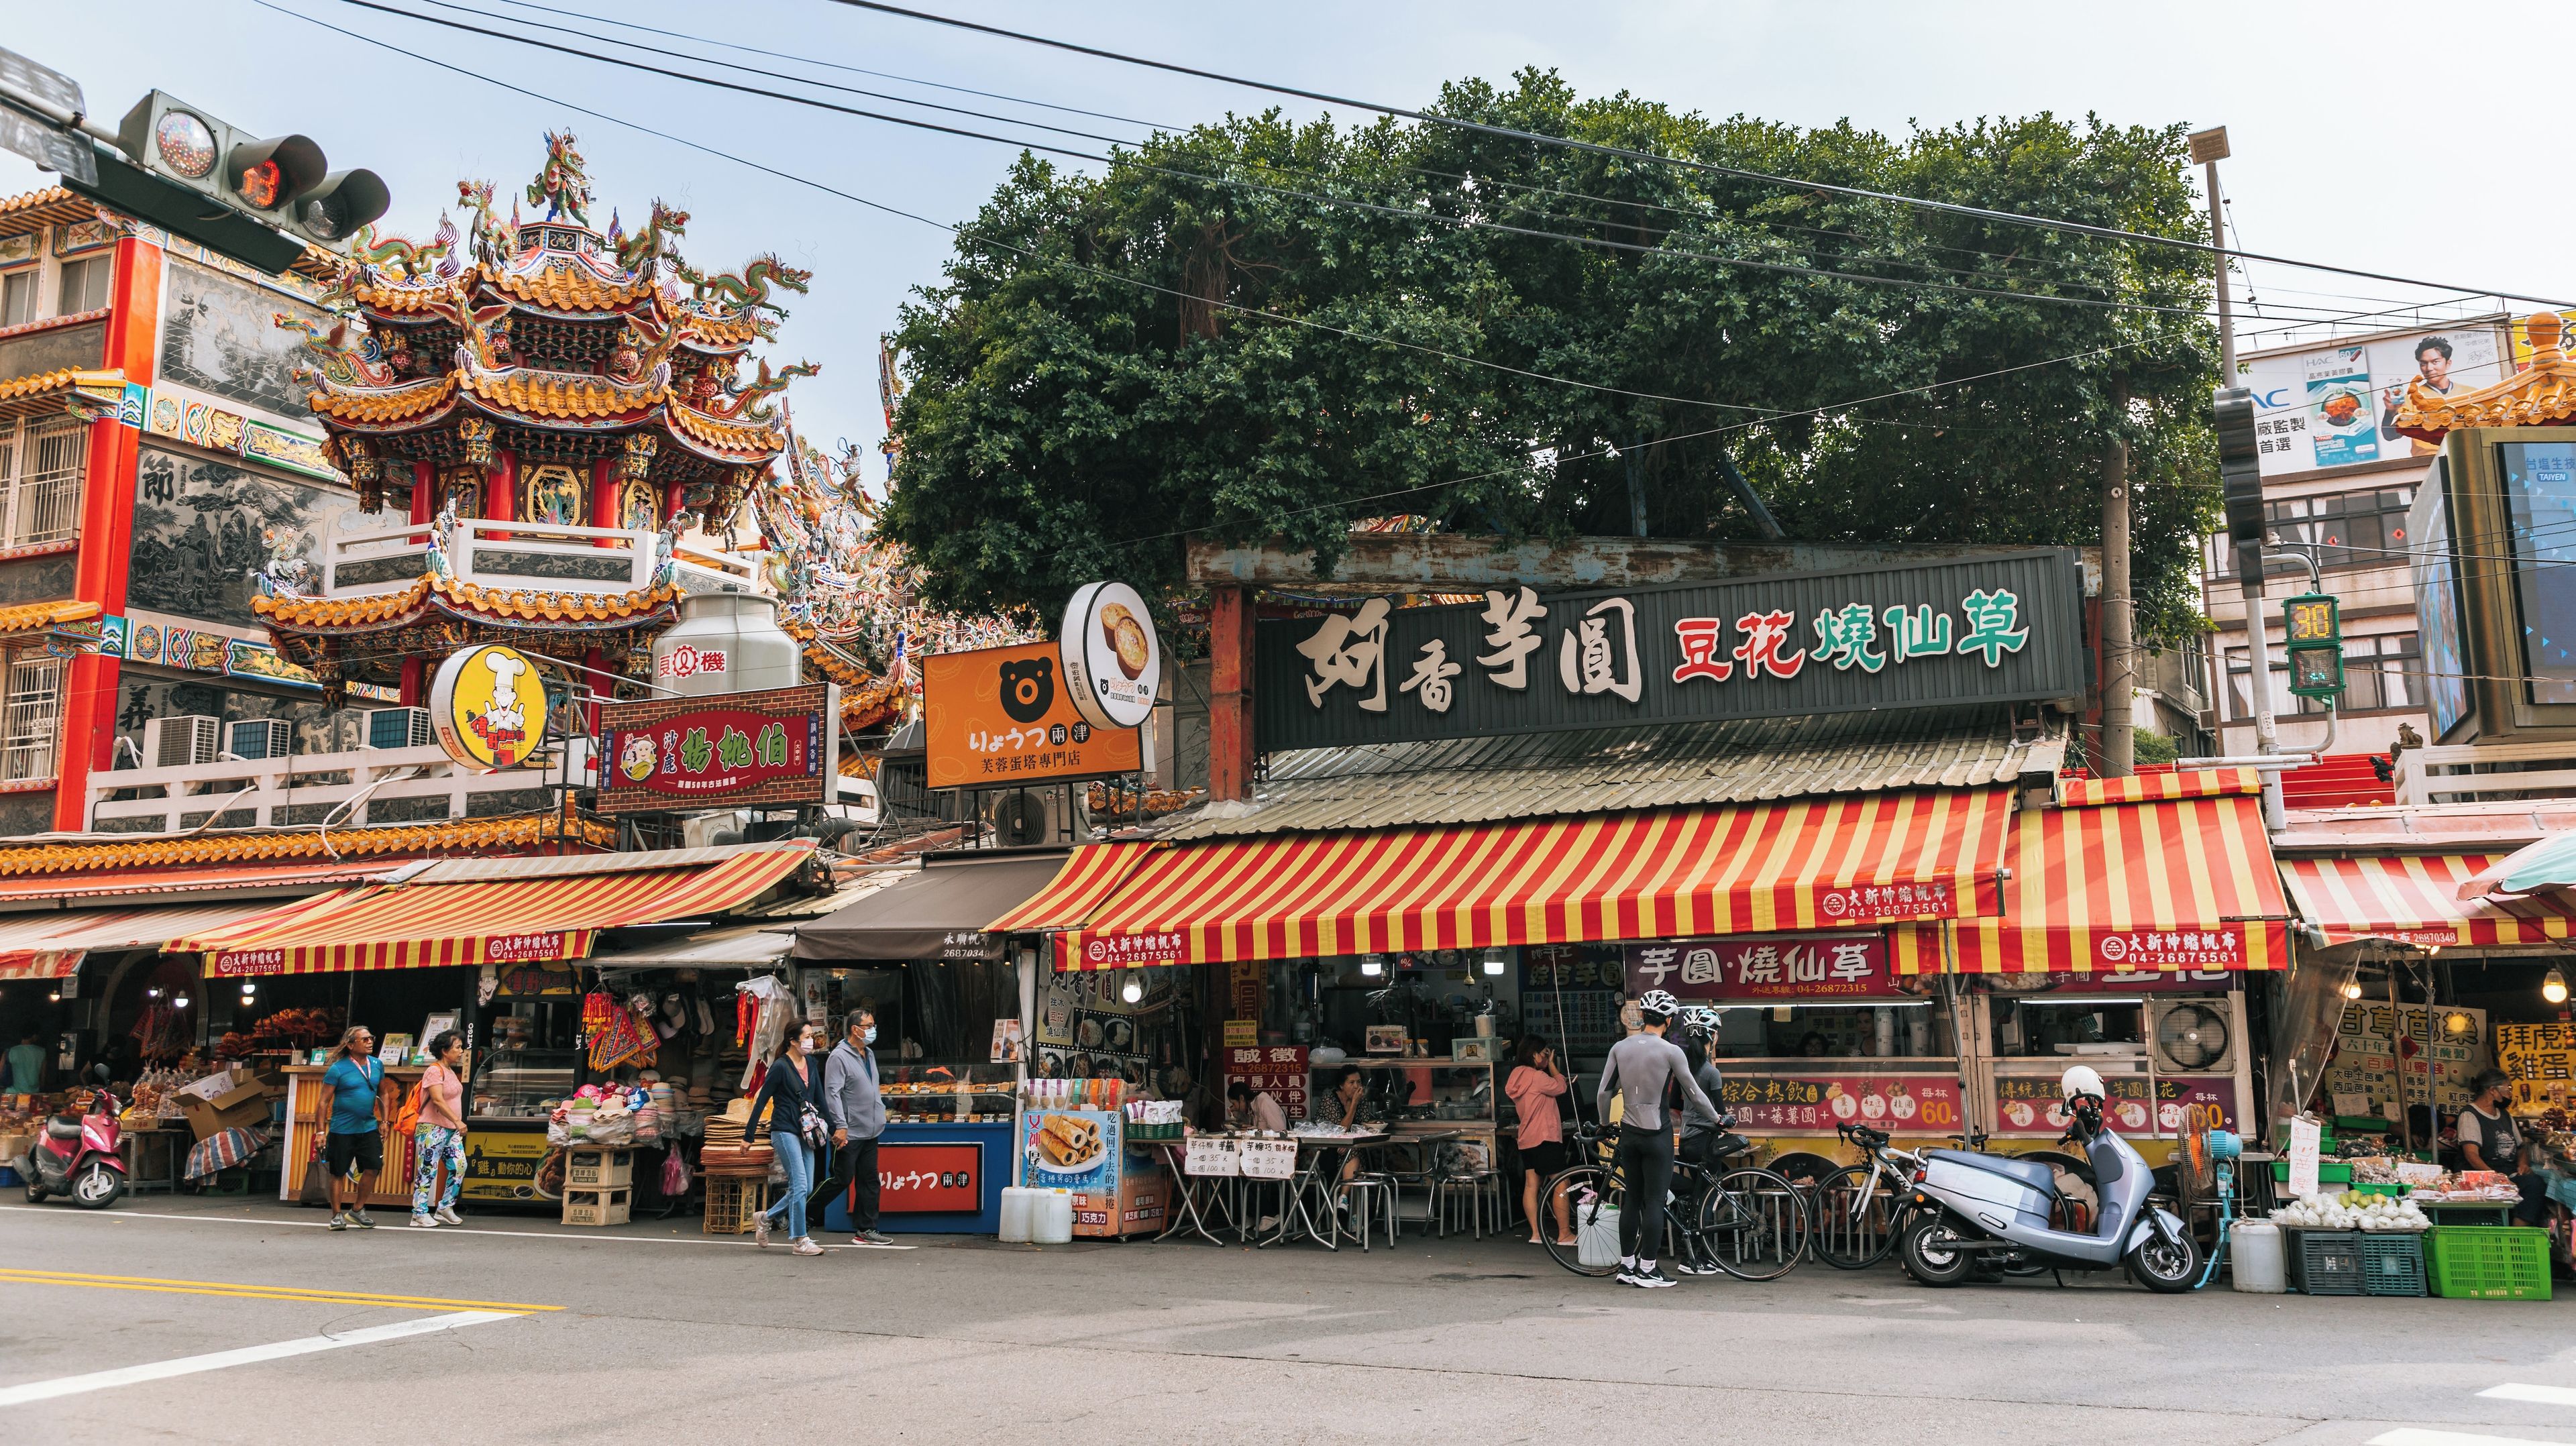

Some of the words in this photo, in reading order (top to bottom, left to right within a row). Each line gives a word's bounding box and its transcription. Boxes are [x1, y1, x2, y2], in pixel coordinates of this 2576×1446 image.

[2306, 356, 2334, 367] HAC
[2257, 416, 2306, 436] 廠監製
[2259, 437, 2292, 454] 首選
[142, 455, 174, 506] 節
[2296, 604, 2330, 638] 30
[119, 683, 155, 732] 義
[681, 722, 787, 773] 楊桃伯
[970, 727, 1046, 752] りょうつ
[661, 730, 680, 775] 沙鹿
[981, 750, 1081, 773] 芙蓉蛋塔專門店
[1849, 883, 1947, 906] 大新伸縮帆布
[1849, 901, 1947, 918] 04-26875561
[504, 934, 559, 951] 大新伸縮帆布
[944, 932, 989, 946] 永順帆布
[1108, 934, 1181, 953] 大新伸縮帆布
[2129, 930, 2237, 953] 大新伸縮帆布
[2414, 932, 2456, 942] 26870348
[233, 951, 281, 966] 大新伸縮帆布
[503, 949, 559, 959] 04-26875561
[944, 949, 989, 958] 26870348
[1107, 950, 1182, 963] 04-26875561
[2129, 950, 2238, 964] 04-26875561
[233, 964, 281, 973] 04-26875561
[1797, 983, 1868, 993] 04-26872315
[1050, 1012, 1064, 1022] 豆花
[2339, 1004, 2478, 1046] 甘草芭樂
[1046, 1026, 1068, 1038] 燒仙草
[1234, 1048, 1297, 1063] 誠徵
[2347, 1040, 2465, 1060] 六十年專業醃製
[2507, 1052, 2572, 1080] 雞蛋
[2334, 1070, 2384, 1083] 大甲土芭樂
[1722, 1079, 1805, 1103] 綜合熱飲
[1921, 1088, 1949, 1098] 每杯
[2333, 1081, 2373, 1093] 西瓜芭樂
[2195, 1093, 2218, 1101] 每杯
[1921, 1101, 1951, 1124] 60
[1028, 1115, 1041, 1148] 女神
[1105, 1113, 1117, 1209] 吃過回不去的蛋捲
[1210, 1154, 1220, 1162] 35
[2292, 1127, 2318, 1192] 紅心芭樂
[879, 1170, 938, 1190] りょうつ
[1072, 1195, 1087, 1206] 原味
[1081, 1212, 1106, 1223] 巧克力
[1150, 1208, 1164, 1218] 巧克力
